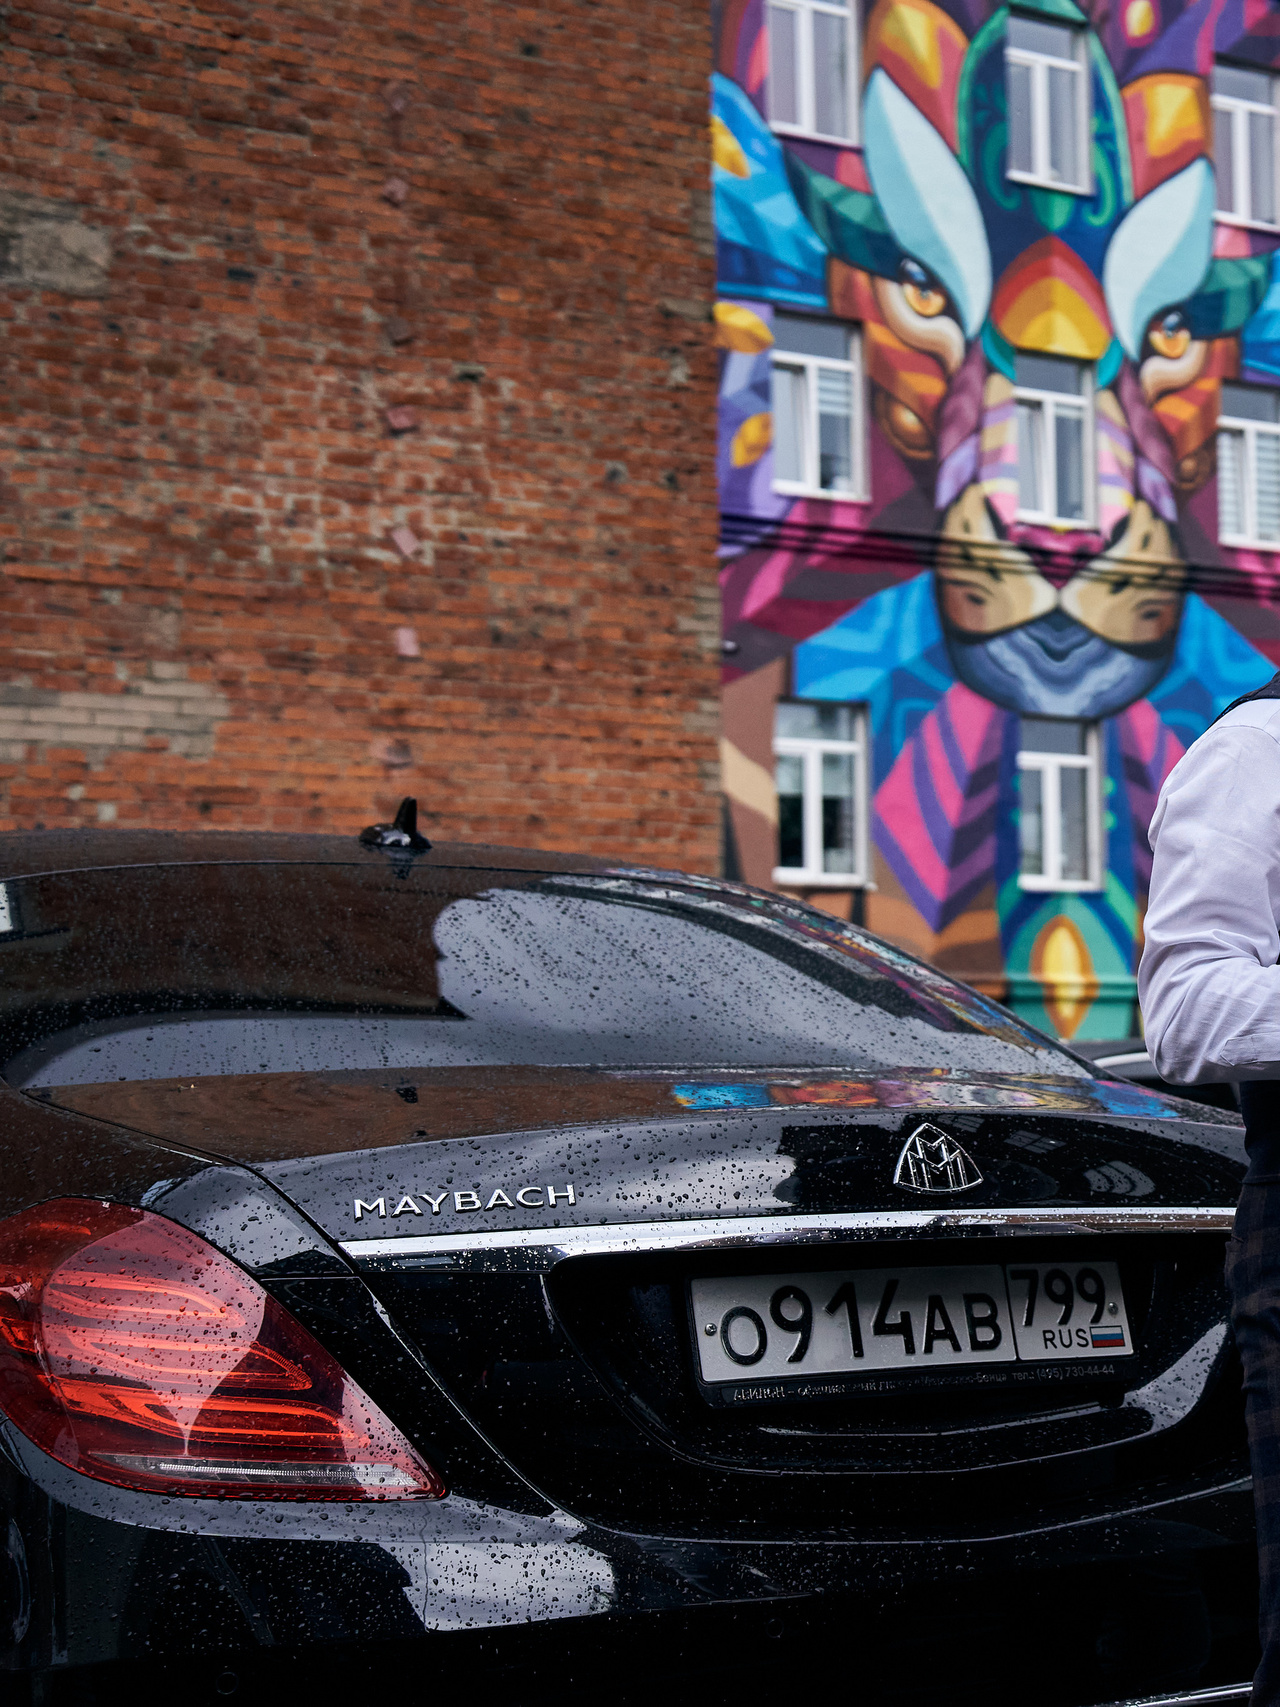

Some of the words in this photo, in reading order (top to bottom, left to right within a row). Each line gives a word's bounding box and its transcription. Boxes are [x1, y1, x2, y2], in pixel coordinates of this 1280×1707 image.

[353, 1184, 577, 1222] MAYBACH
[1010, 1267, 1106, 1327] 799
[1042, 1328, 1090, 1350] RUS
[1036, 1366, 1063, 1382] (495)
[1065, 1363, 1116, 1378] 730-44-44
